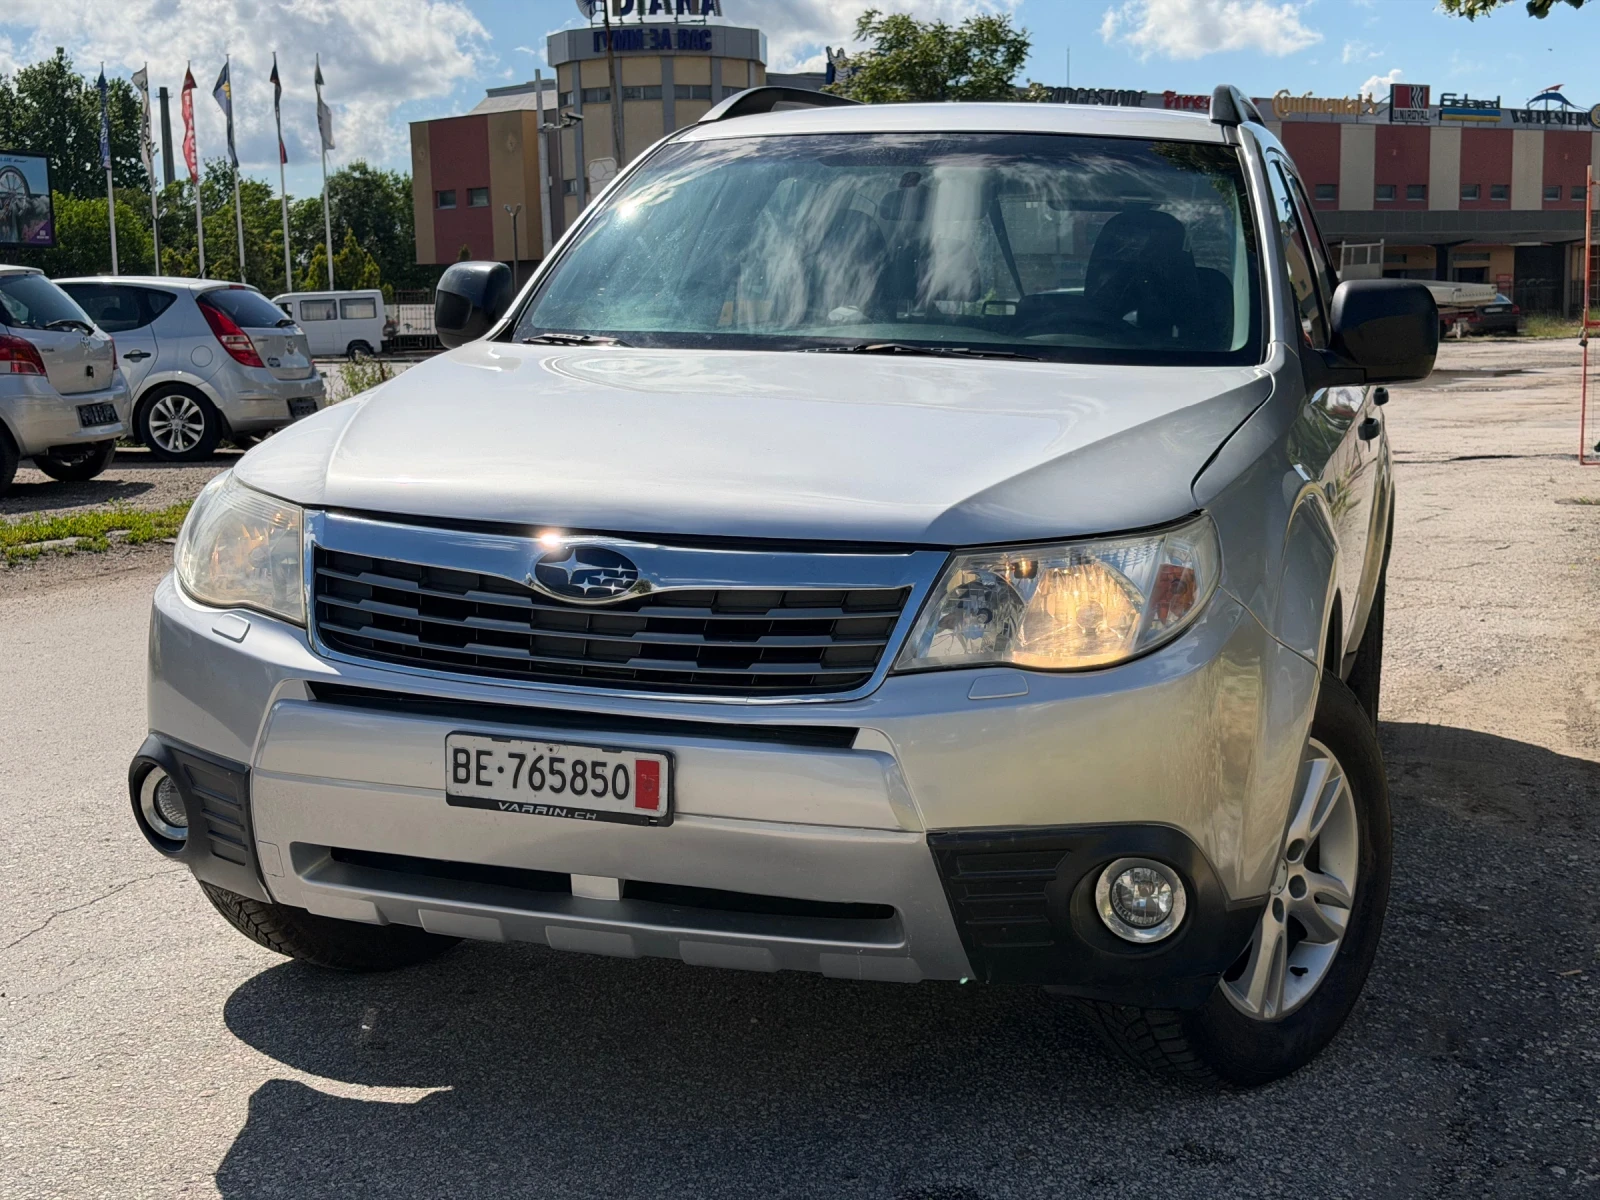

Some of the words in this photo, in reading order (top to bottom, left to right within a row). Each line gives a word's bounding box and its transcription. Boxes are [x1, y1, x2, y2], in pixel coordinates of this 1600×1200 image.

[611, 0, 722, 17] DIANA
[650, 28, 672, 50] ЗА
[678, 28, 712, 51] ВАС
[1040, 86, 1147, 107] RIDGESTONE
[1272, 89, 1363, 119] Continental
[1394, 109, 1429, 121] UNIROYAL
